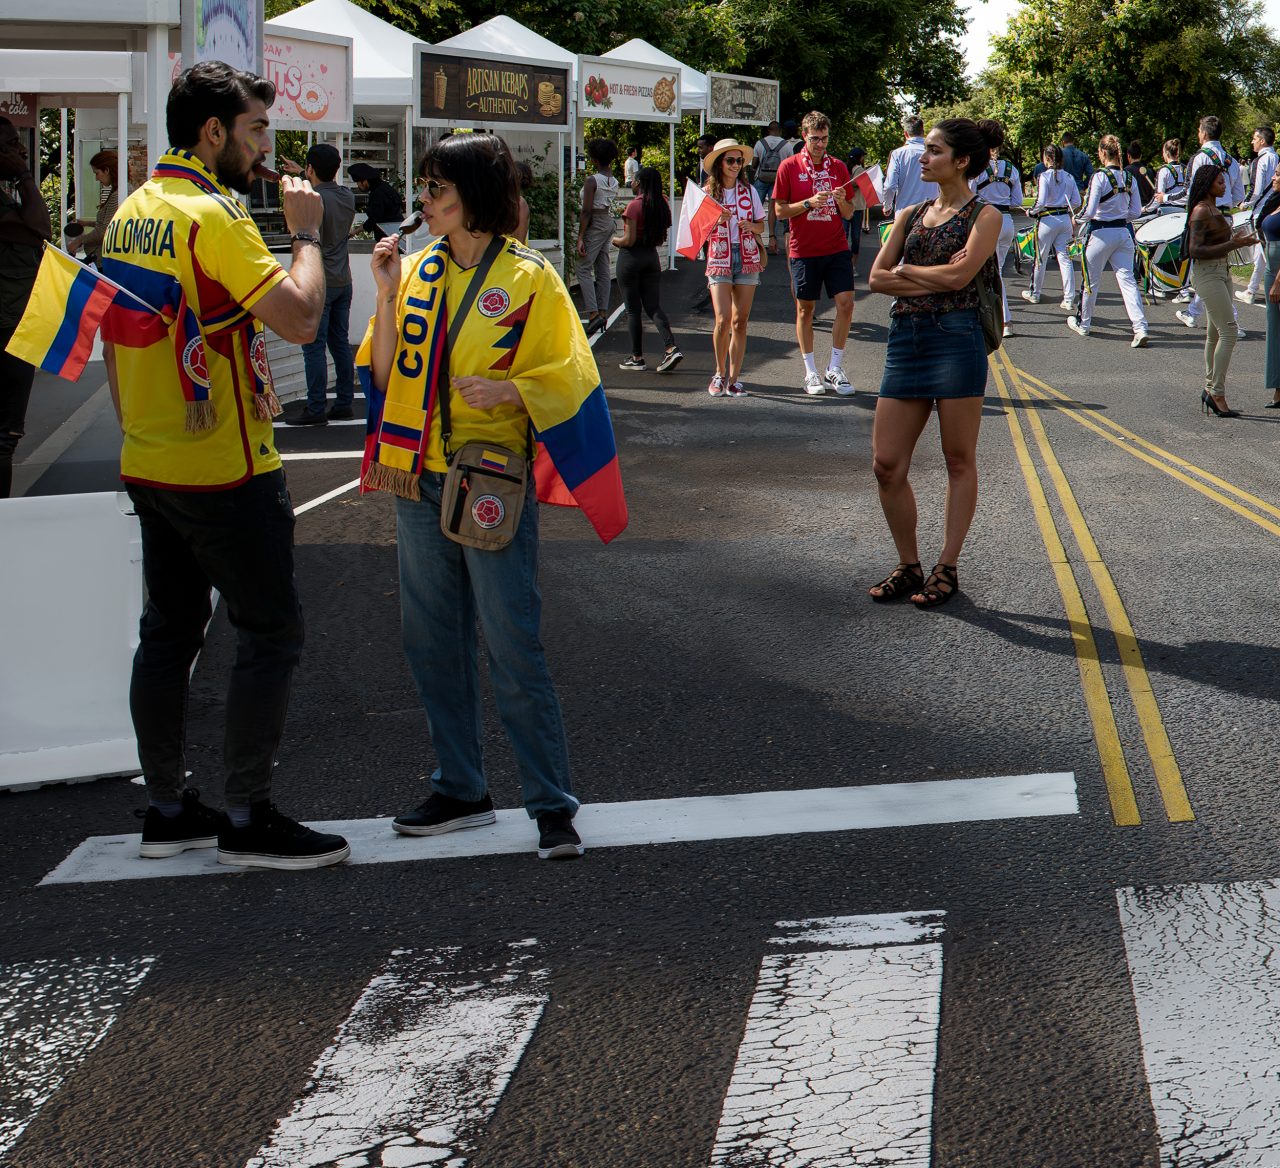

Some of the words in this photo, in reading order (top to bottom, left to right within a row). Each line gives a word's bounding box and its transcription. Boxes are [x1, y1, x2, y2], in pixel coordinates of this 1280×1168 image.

[466, 67, 500, 97] ARTISAN
[501, 71, 529, 100] KEBAPS
[609, 83, 619, 95] HOT
[619, 85, 624, 95] &
[623, 84, 638, 97] FRESH
[638, 86, 653, 98] PIZZAS
[479, 97, 518, 115] AUTHENTIC
[103, 218, 176, 259] OLOMBIA
